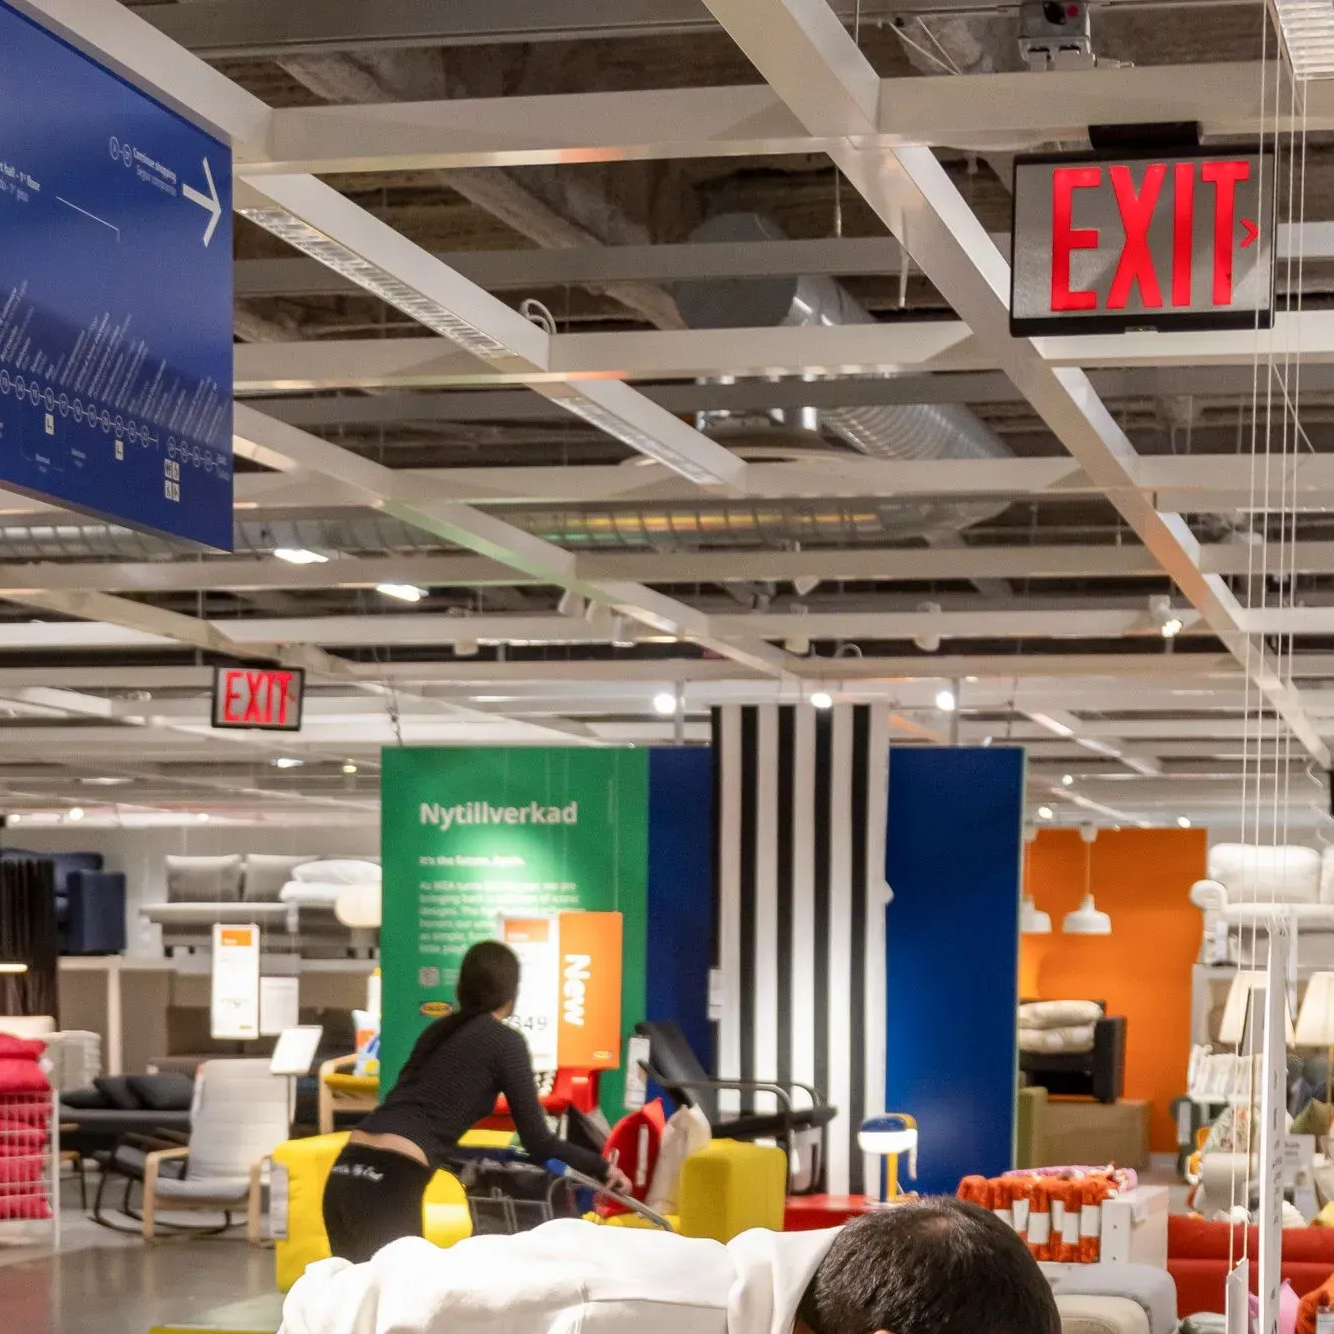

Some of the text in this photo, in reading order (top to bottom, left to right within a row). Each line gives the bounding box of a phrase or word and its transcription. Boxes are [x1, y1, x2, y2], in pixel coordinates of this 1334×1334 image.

[1051, 161, 1250, 311] EXIT
[224, 671, 293, 724] EXIT
[419, 802, 578, 831] Nytillverkad
[563, 954, 591, 1028] New
